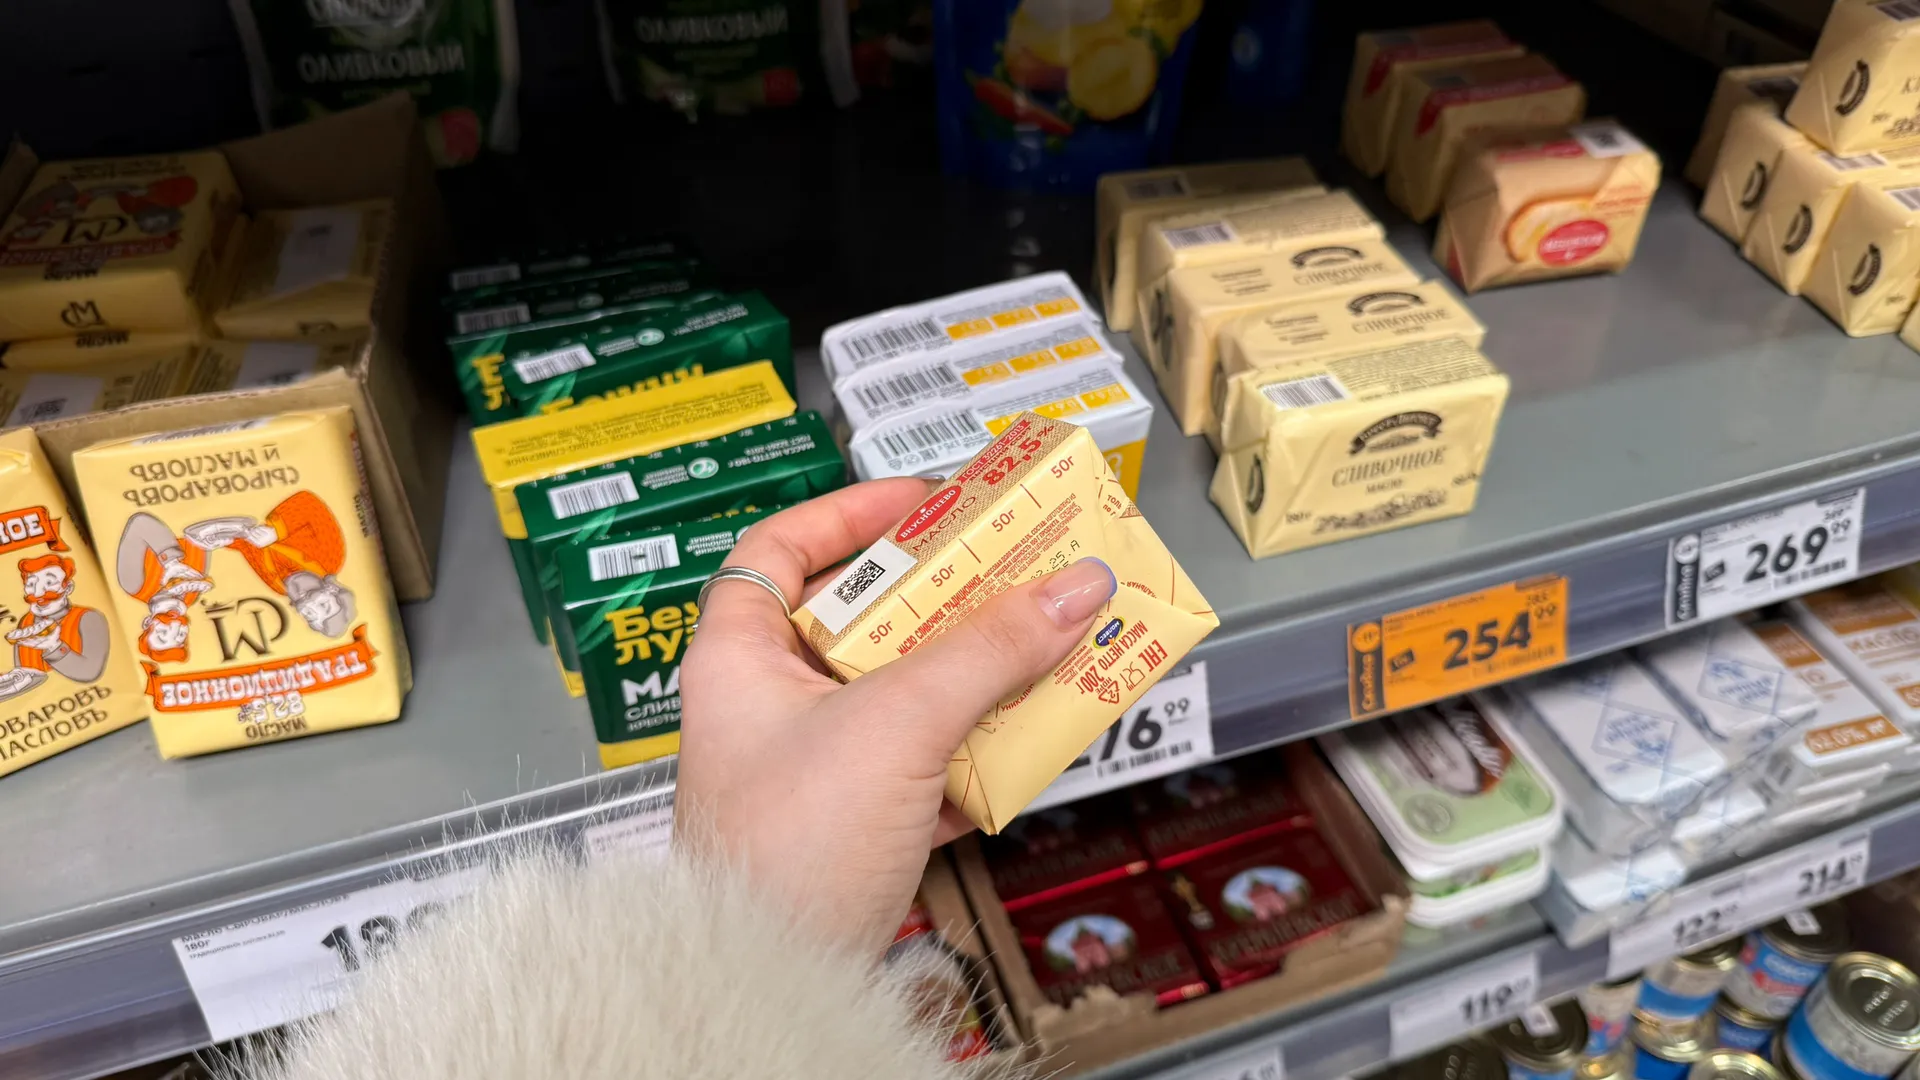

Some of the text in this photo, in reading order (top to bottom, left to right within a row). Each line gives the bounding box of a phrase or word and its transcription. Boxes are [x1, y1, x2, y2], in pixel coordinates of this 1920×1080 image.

[130, 448, 258, 484] МАСЛОВЪ
[1049, 453, 1077, 479] 50г
[1331, 445, 1448, 488] СЛИВОЧНОЕ
[123, 466, 302, 507] СЫРОВАРОВЪ
[897, 487, 958, 539] ВКУСНОТЕЕВО
[910, 494, 979, 552] МАСЛО
[990, 507, 1018, 533] 50г
[1743, 525, 1829, 584] 269
[1831, 519, 1851, 536] 99
[929, 562, 958, 588] 50г
[867, 618, 896, 645] 50г
[895, 634, 918, 656] МАСЛО
[913, 607, 947, 640] СЛИВОЧНОЕ
[1095, 619, 1121, 644] МОЛВЕСТ
[1118, 620, 1148, 650] МАССА
[1444, 611, 1531, 670] 254
[1053, 643, 1088, 678] www.molvest.ru
[1095, 642, 1125, 671] НЕТТО
[160, 649, 368, 709] ТРАДИЦИОННОЕ
[1077, 664, 1106, 693] 200
[1094, 676, 1112, 694] HDPE
[1163, 697, 1191, 719] 99
[245, 715, 307, 740] МАСЛО
